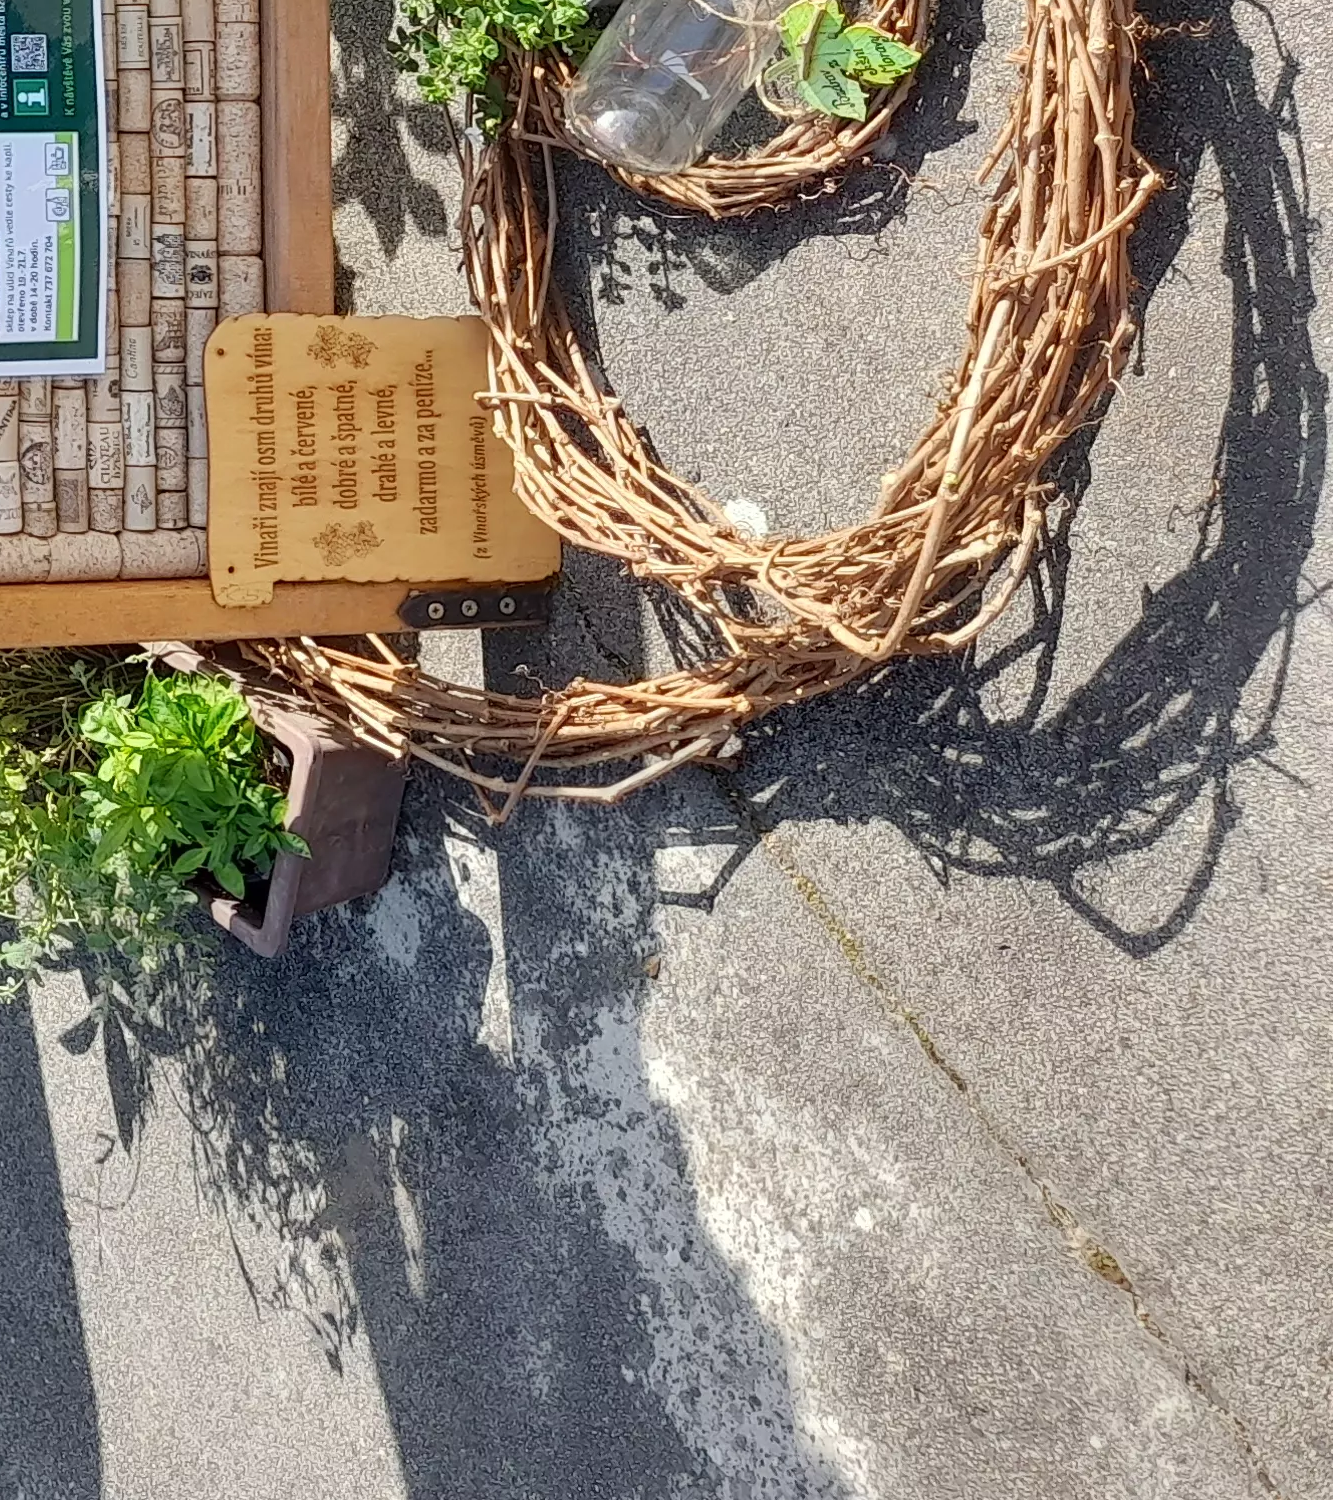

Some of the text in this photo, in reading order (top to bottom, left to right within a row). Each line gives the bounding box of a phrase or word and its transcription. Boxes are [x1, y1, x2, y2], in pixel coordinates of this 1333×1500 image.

[819, 69, 856, 110] Pozdrav
[868, 35, 902, 75] Moravy
[99, 426, 111, 484] CHATEAU
[246, 326, 283, 570] Vinaři znají osm druhů vína:
[288, 385, 318, 508] bílé a červené,
[331, 379, 363, 510] dobré a špatné,
[369, 384, 398, 503] drahé a levné,
[407, 349, 442, 535] zadarmo a za peníze...
[468, 415, 488, 470] úsměvů)
[469, 473, 490, 544] Vinařských
